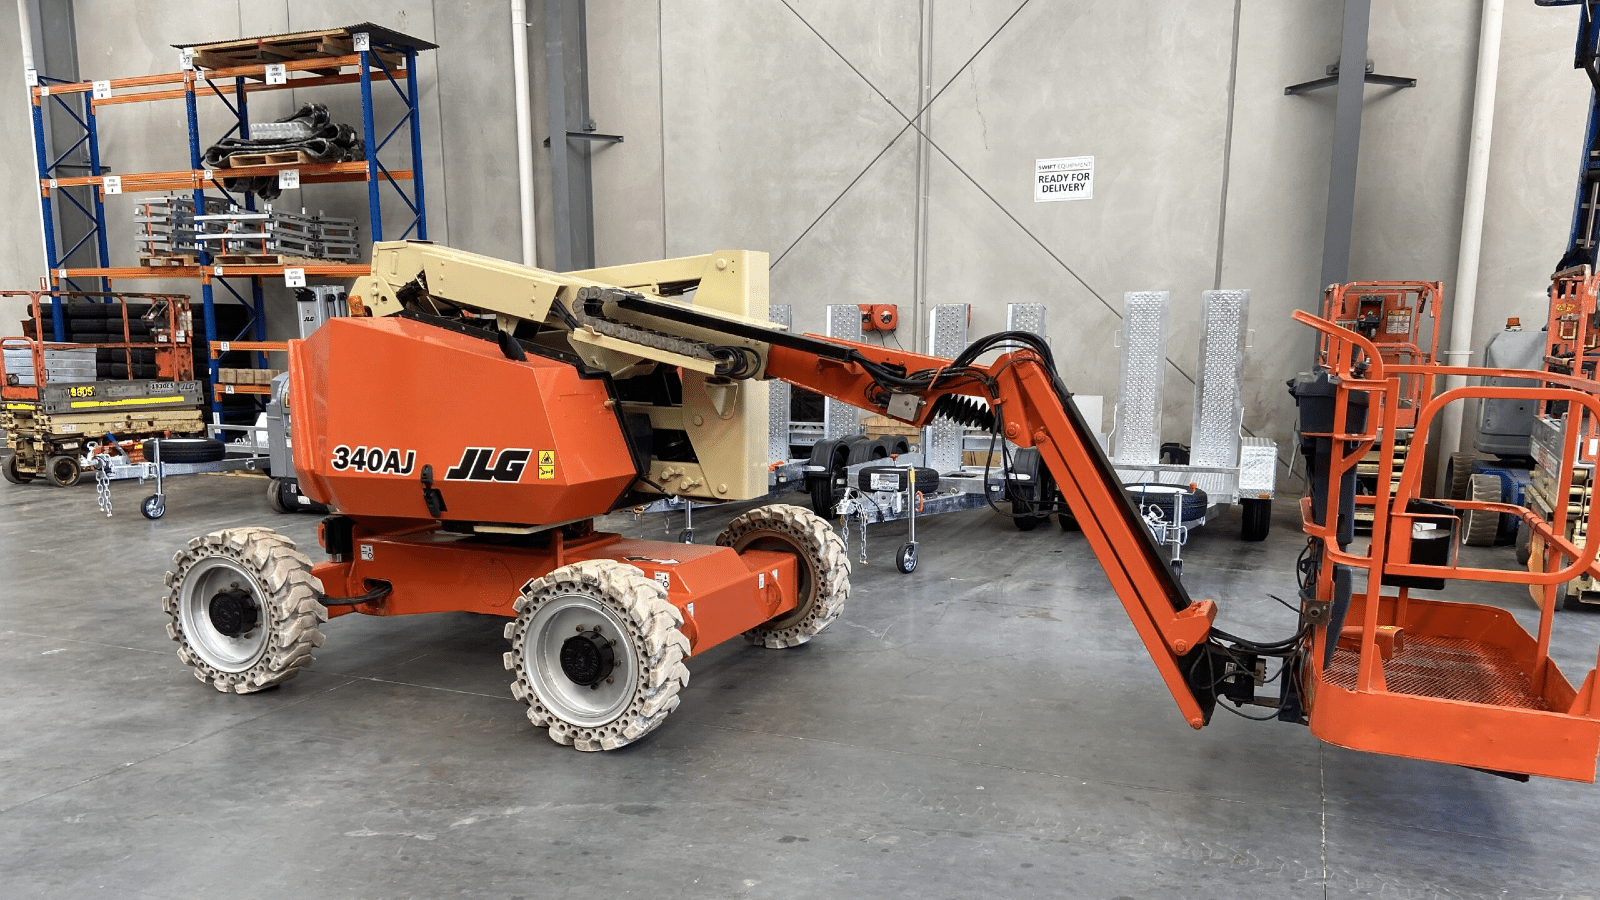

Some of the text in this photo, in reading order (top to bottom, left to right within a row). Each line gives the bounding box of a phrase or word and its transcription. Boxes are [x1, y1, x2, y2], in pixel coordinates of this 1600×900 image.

[356, 36, 366, 45] P3
[1038, 172, 1090, 183] READY FOR
[1042, 182, 1085, 193] DELIVERY
[331, 445, 417, 476] 340AJ
[444, 446, 533, 483] JLG
